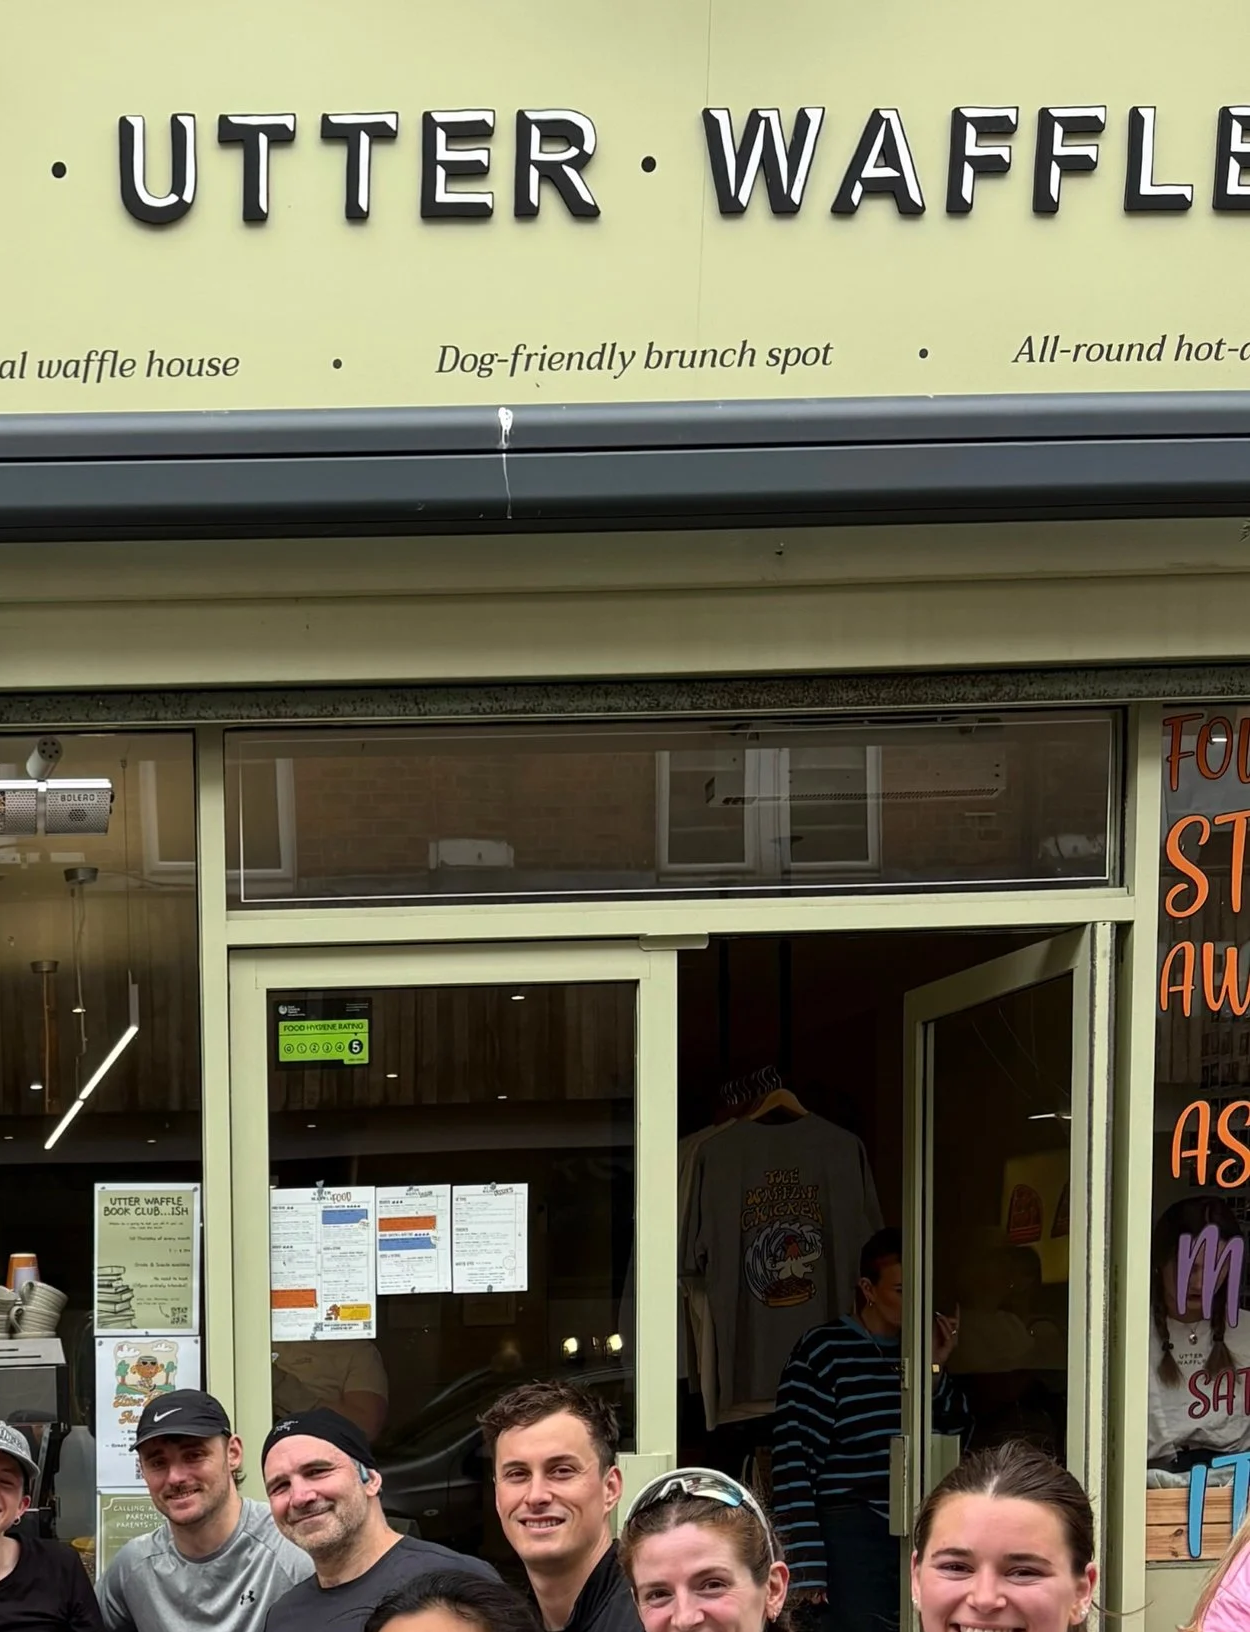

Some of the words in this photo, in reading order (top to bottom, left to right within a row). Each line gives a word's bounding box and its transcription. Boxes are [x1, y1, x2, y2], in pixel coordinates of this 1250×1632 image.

[118, 106, 602, 225] UTTER
[1011, 334, 1162, 364] All-round
[435, 340, 636, 379] Dog-friendly
[643, 340, 757, 370] brunch
[764, 340, 834, 374] spot
[36, 348, 136, 384] waffle
[145, 348, 240, 378] house
[59, 793, 96, 803] BOLERO
[306, 1023, 338, 1032] HYGIENE
[338, 1022, 364, 1030] RATING
[351, 1040, 361, 1053] 5
[110, 1197, 141, 1206] UTTER
[144, 1197, 183, 1206] WAFFLE
[103, 1206, 131, 1217] BOOK
[741, 1200, 823, 1232] CHICKEN
[1178, 1352, 1203, 1360] UTTER
[125, 1513, 158, 1521] PARENTS
